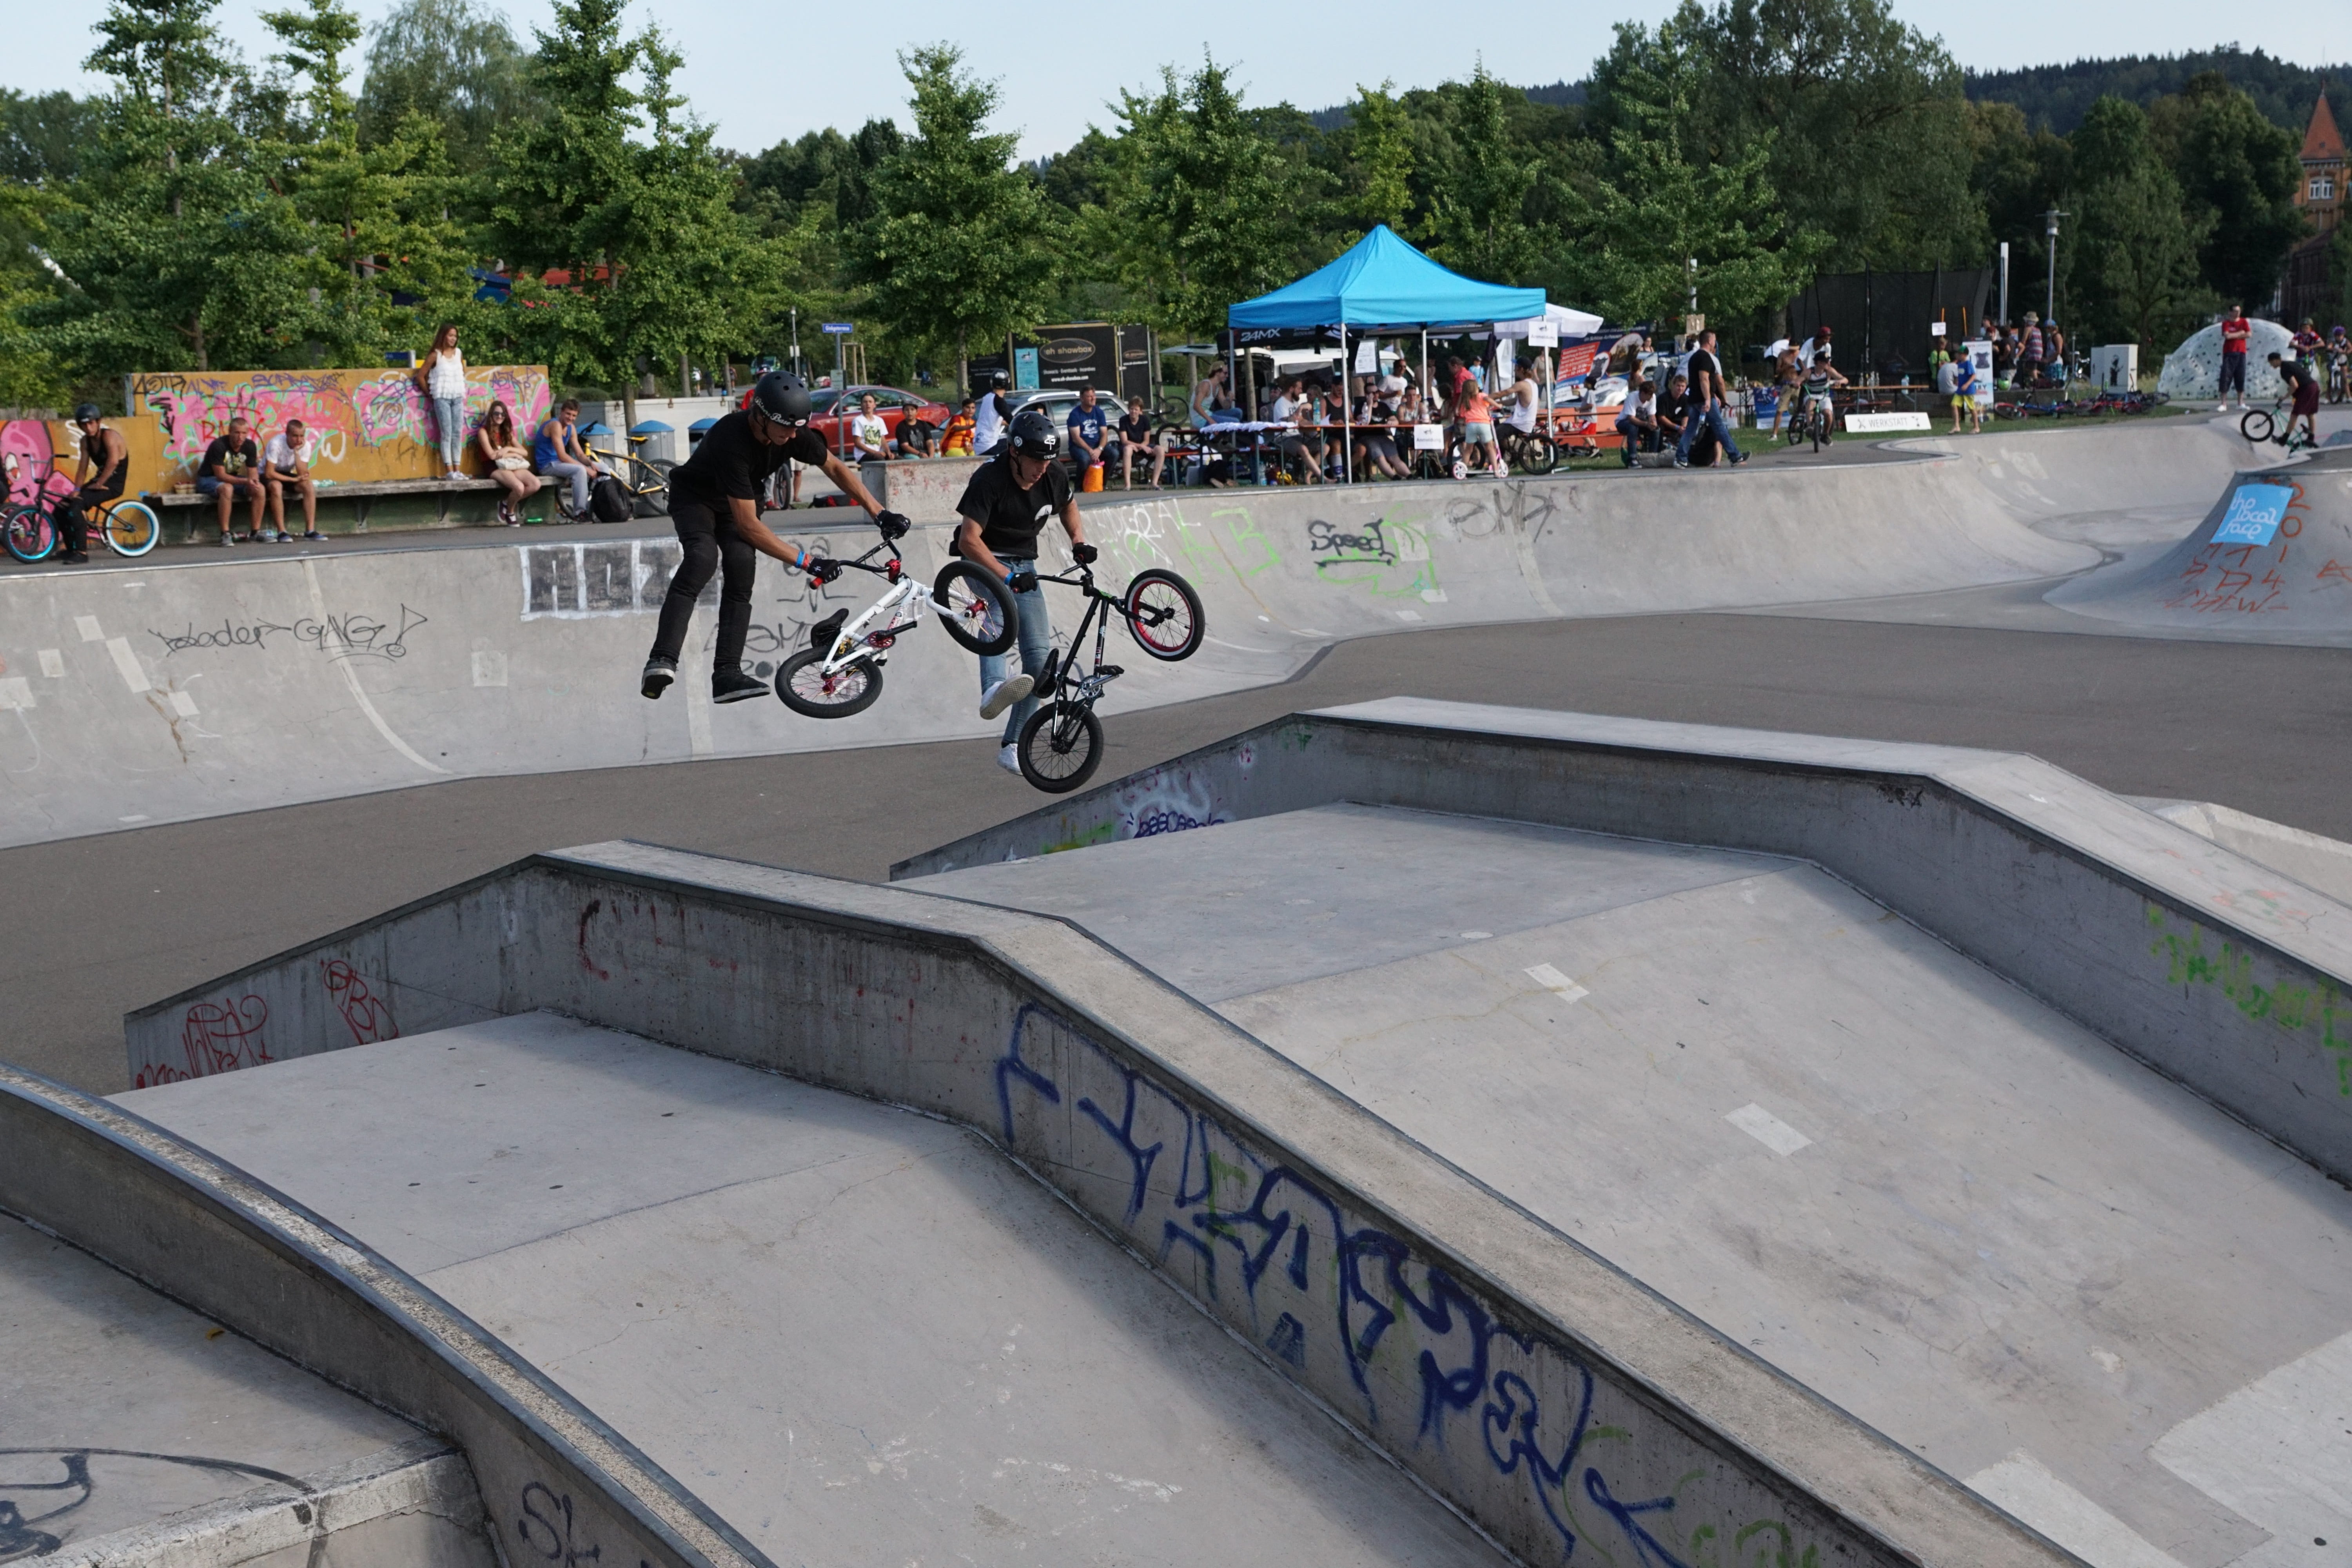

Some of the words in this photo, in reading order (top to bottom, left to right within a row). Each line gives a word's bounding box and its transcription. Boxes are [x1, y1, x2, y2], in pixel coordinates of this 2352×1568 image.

[1240, 328, 1281, 342] 24MX
[1058, 346, 1092, 354] showbox
[770, 413, 791, 425] Base
[1868, 417, 1907, 428] WERKSTATT
[2229, 492, 2256, 510] the
[2234, 507, 2278, 525] local
[2219, 521, 2262, 539] face
